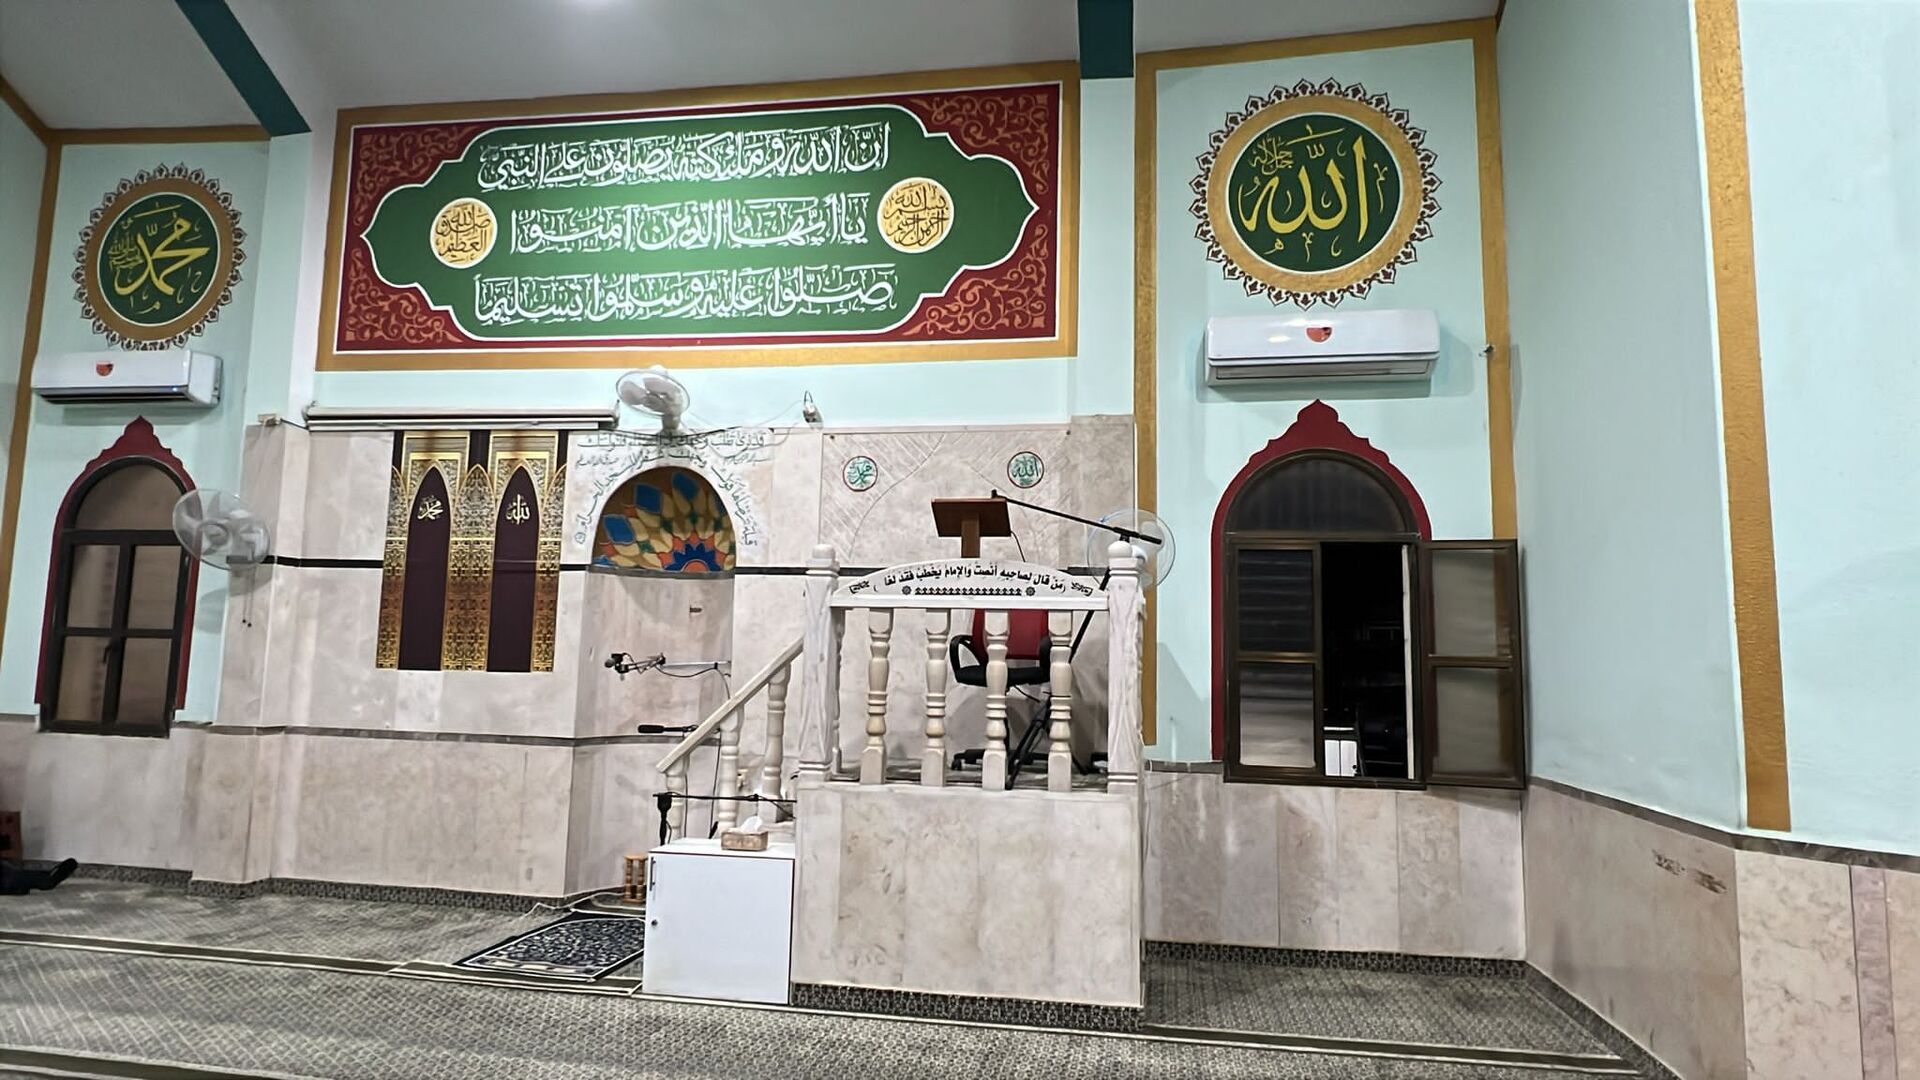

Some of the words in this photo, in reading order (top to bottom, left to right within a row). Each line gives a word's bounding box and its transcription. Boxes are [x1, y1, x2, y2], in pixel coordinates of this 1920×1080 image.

[776, 126, 841, 176] الله
[1238, 135, 1369, 243] الله
[114, 218, 211, 296] محمد
